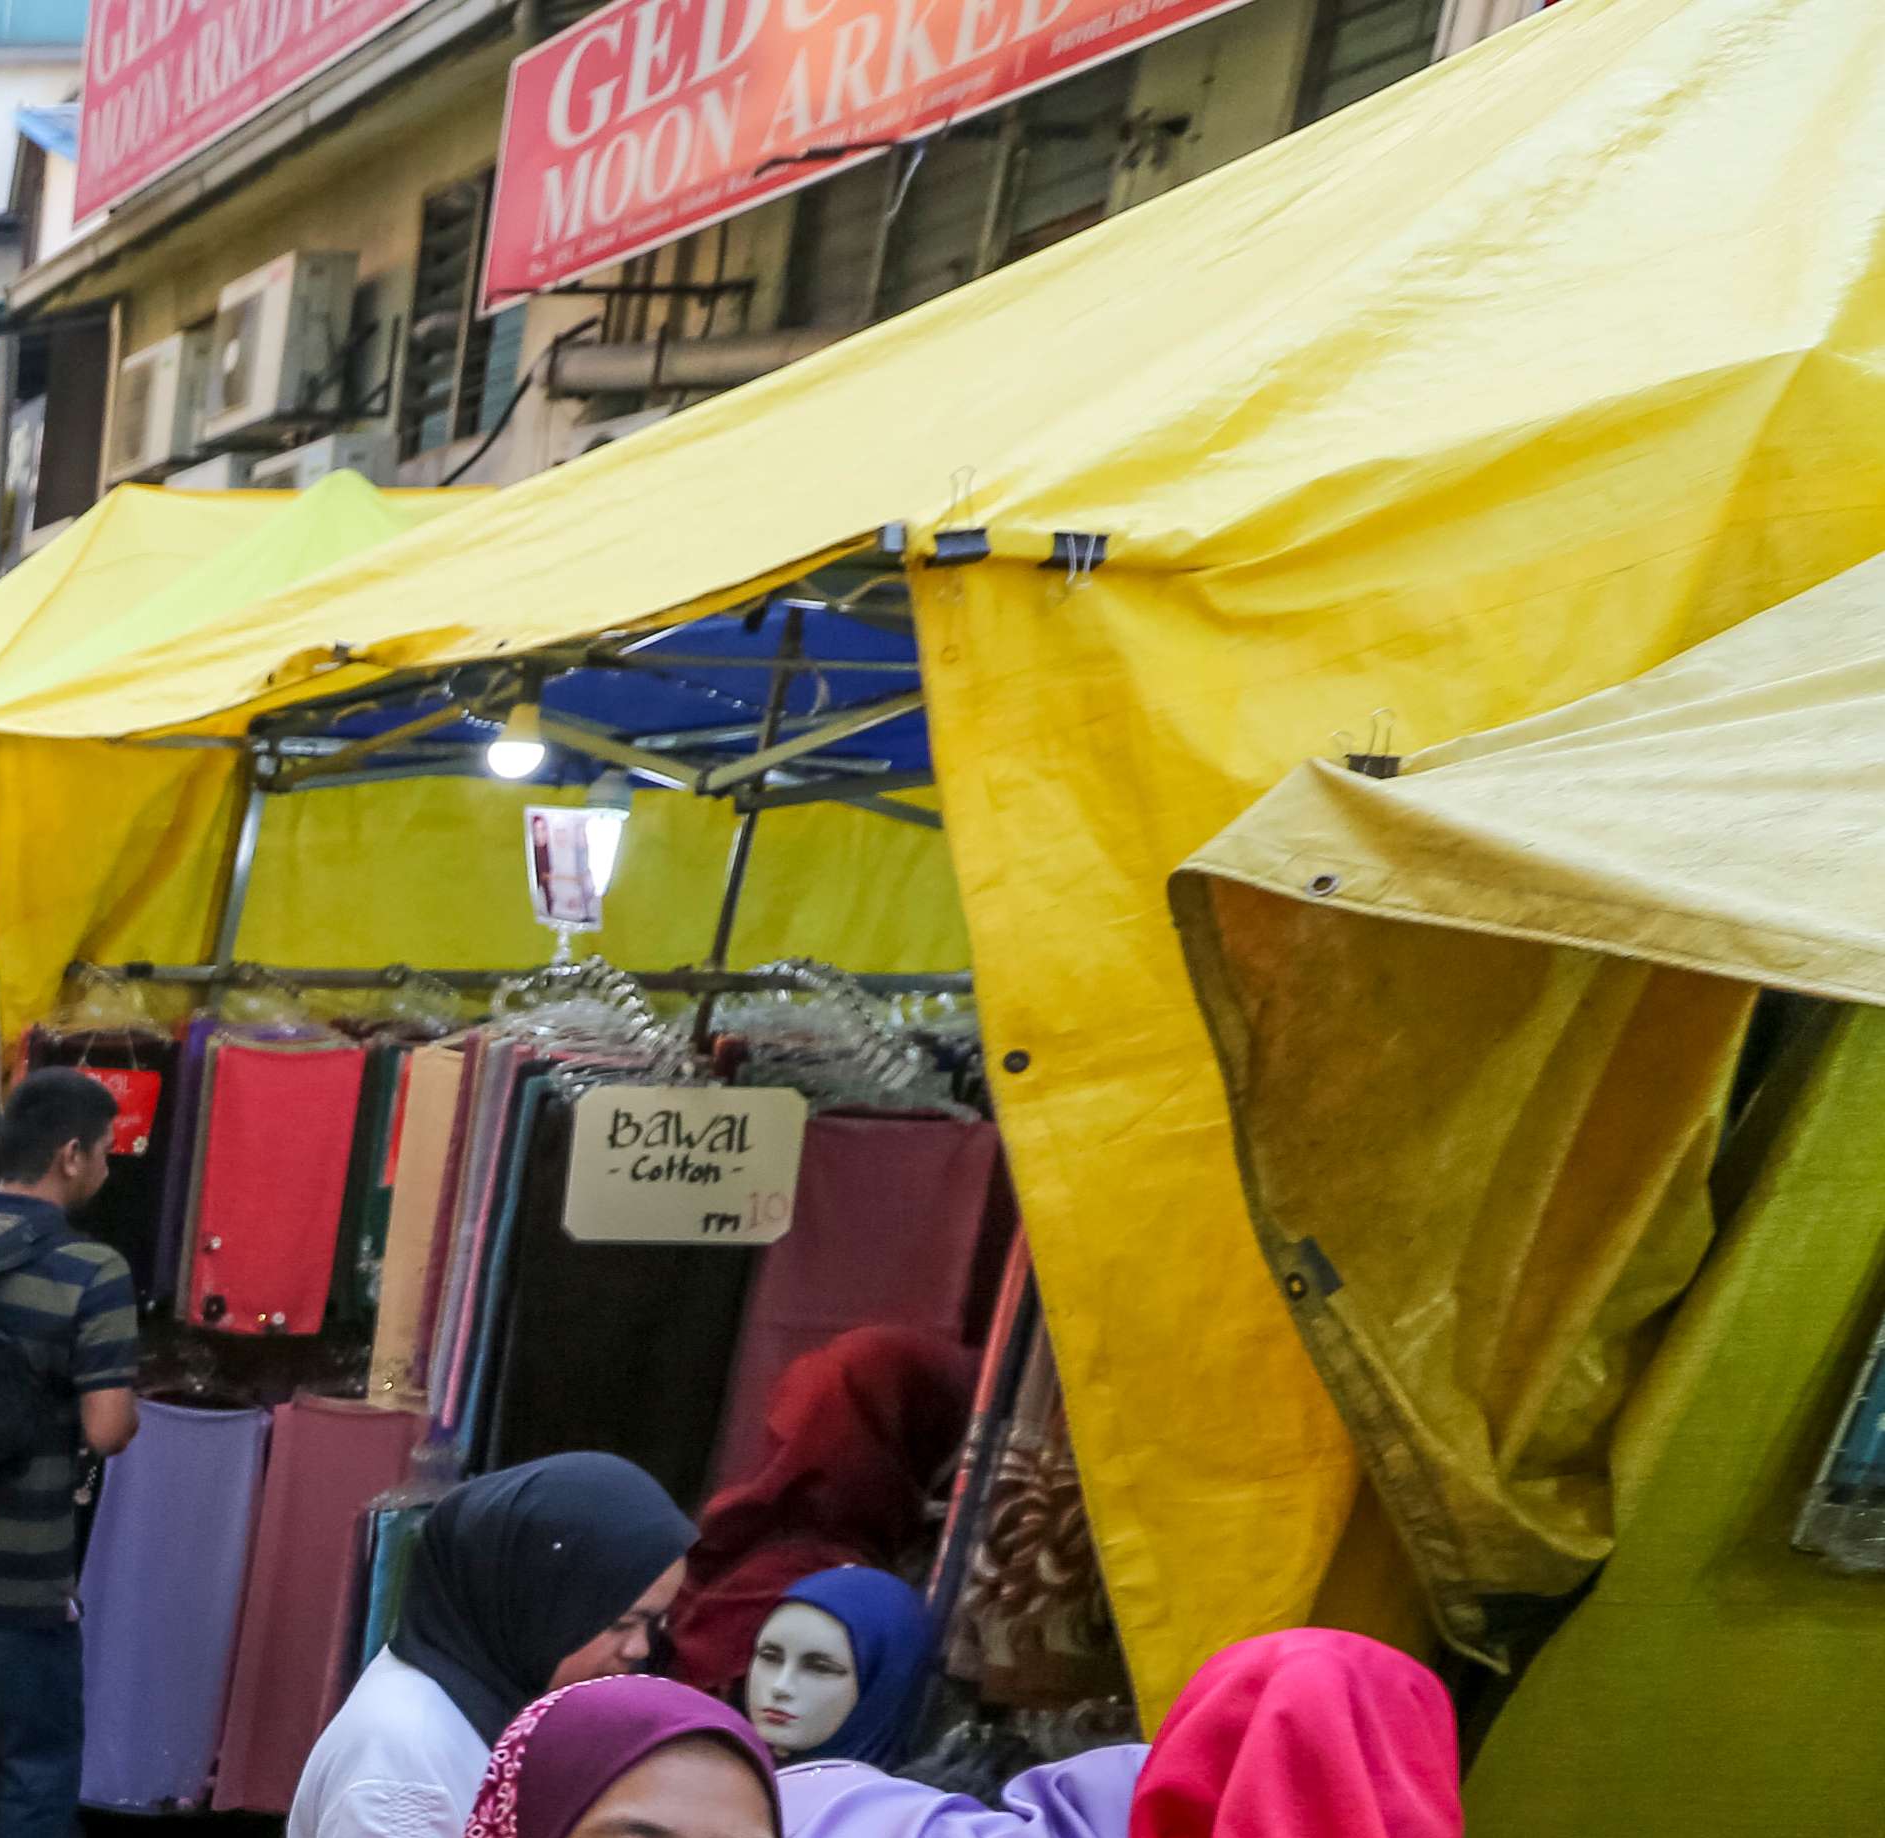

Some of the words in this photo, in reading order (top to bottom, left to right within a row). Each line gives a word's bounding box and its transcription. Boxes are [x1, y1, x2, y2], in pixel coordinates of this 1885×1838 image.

[88, 50, 176, 180] MOON
[532, 70, 748, 256] MOON
[631, 1154, 722, 1186] Cotton
[746, 1190, 790, 1231] 10
